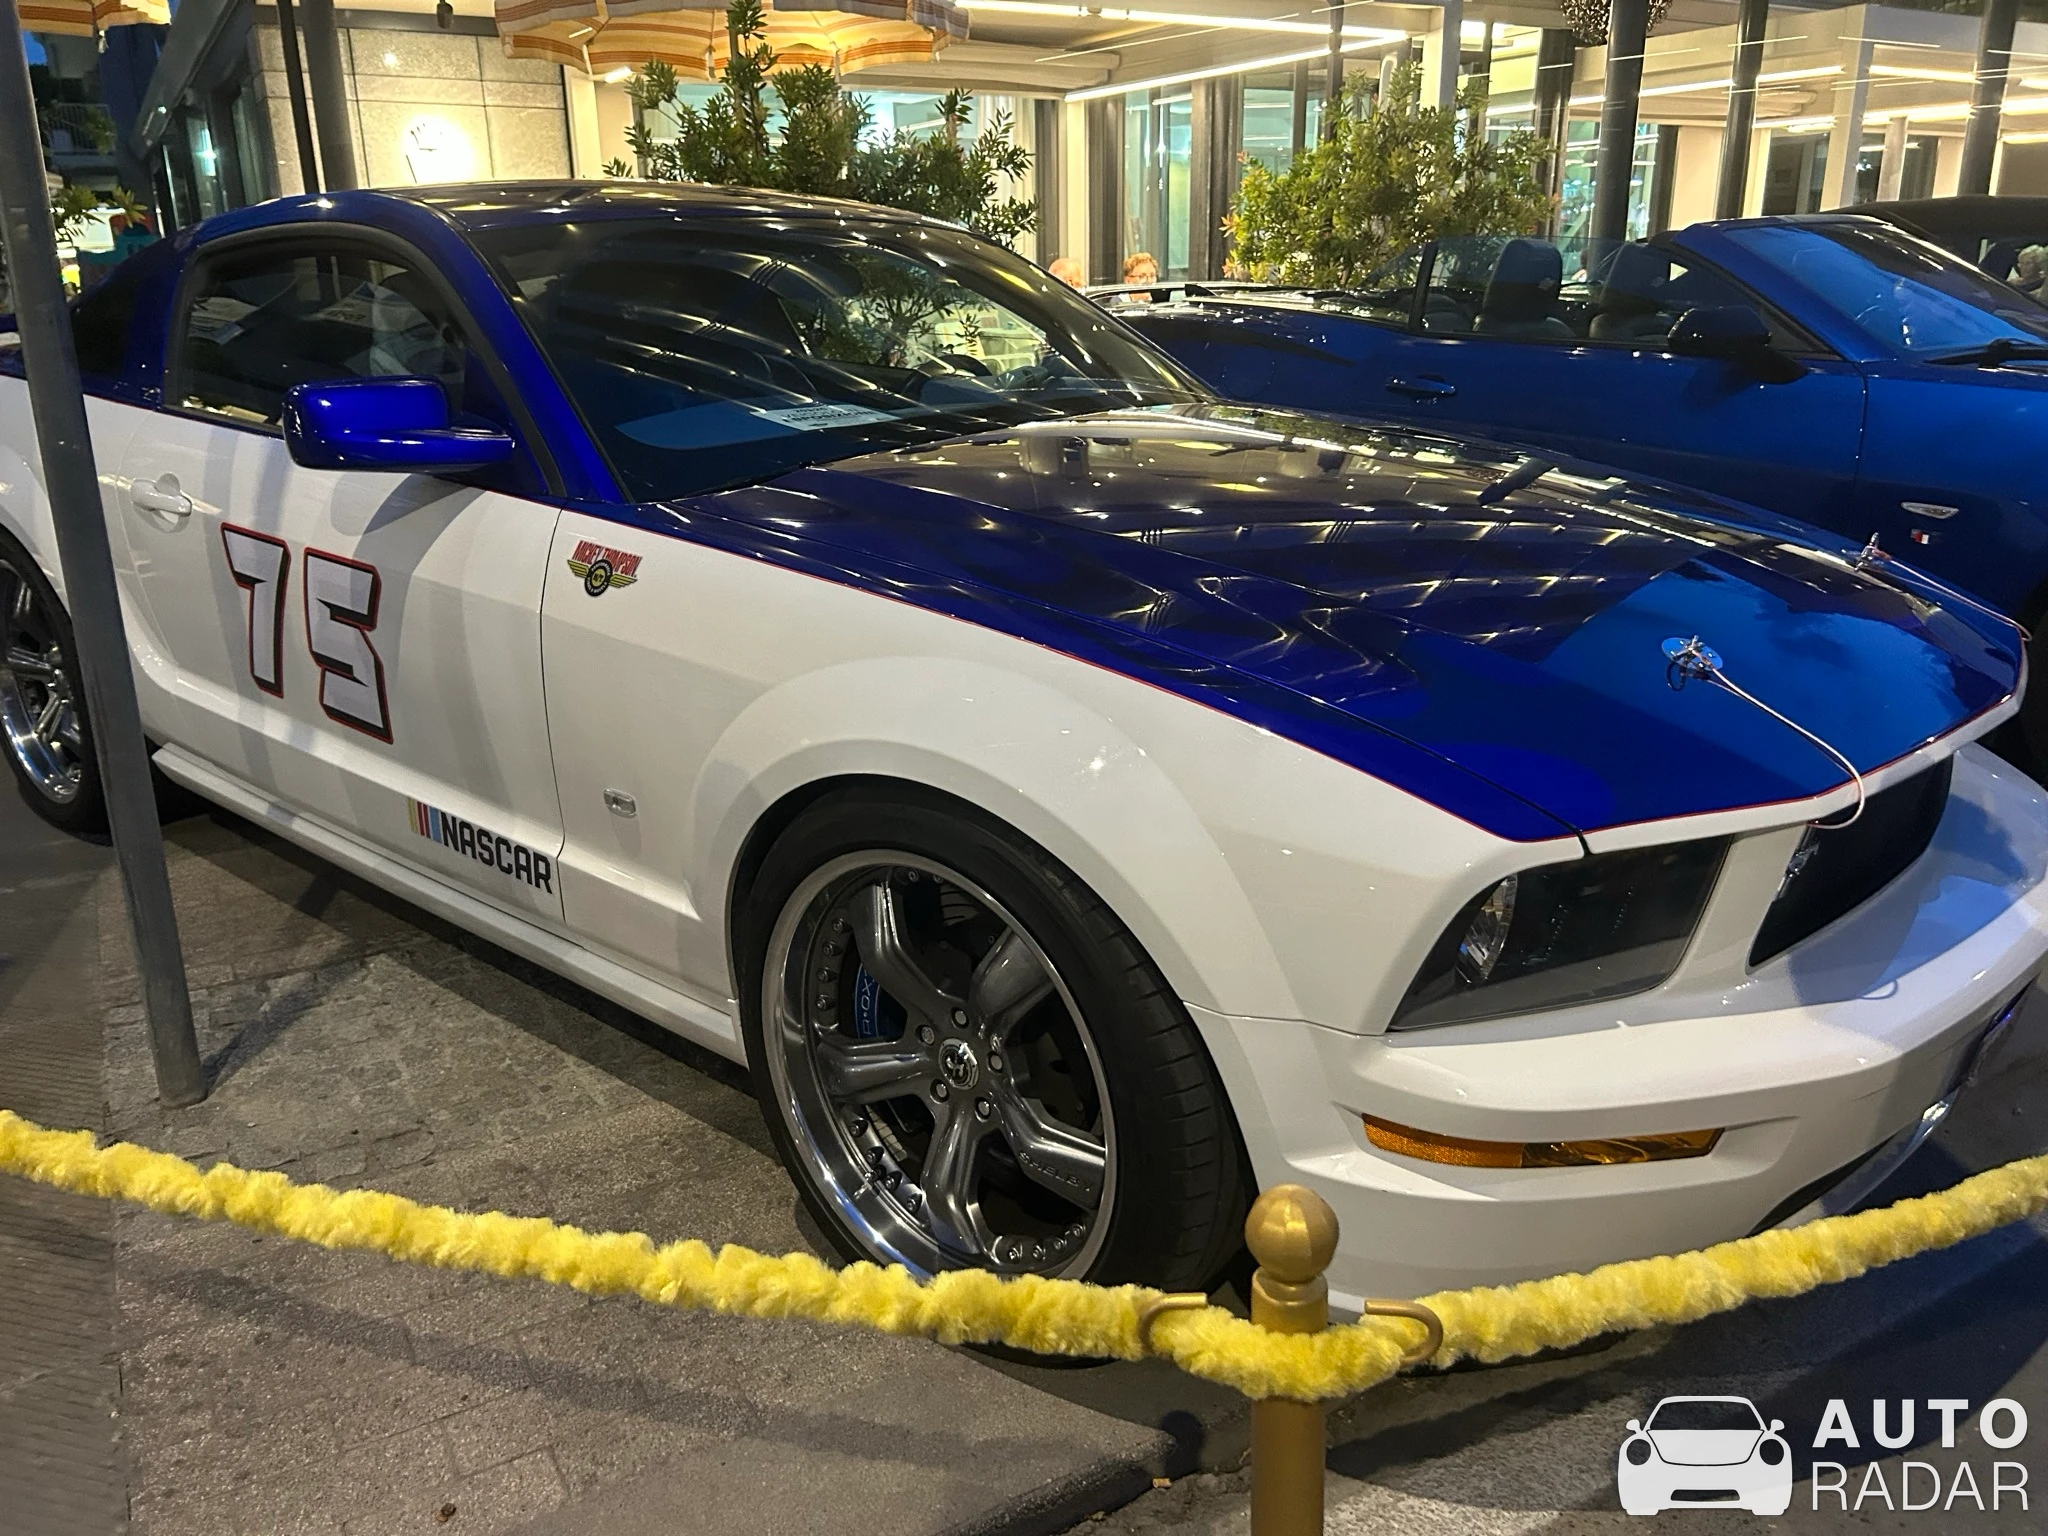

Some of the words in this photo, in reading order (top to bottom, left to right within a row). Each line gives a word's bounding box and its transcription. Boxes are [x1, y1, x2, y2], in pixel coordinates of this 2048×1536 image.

[571, 539, 604, 566] MICKEY
[602, 547, 643, 578] THOMPSON
[221, 522, 393, 744] 75
[440, 811, 553, 895] NASCAR
[1019, 1151, 1093, 1192] SHELBY
